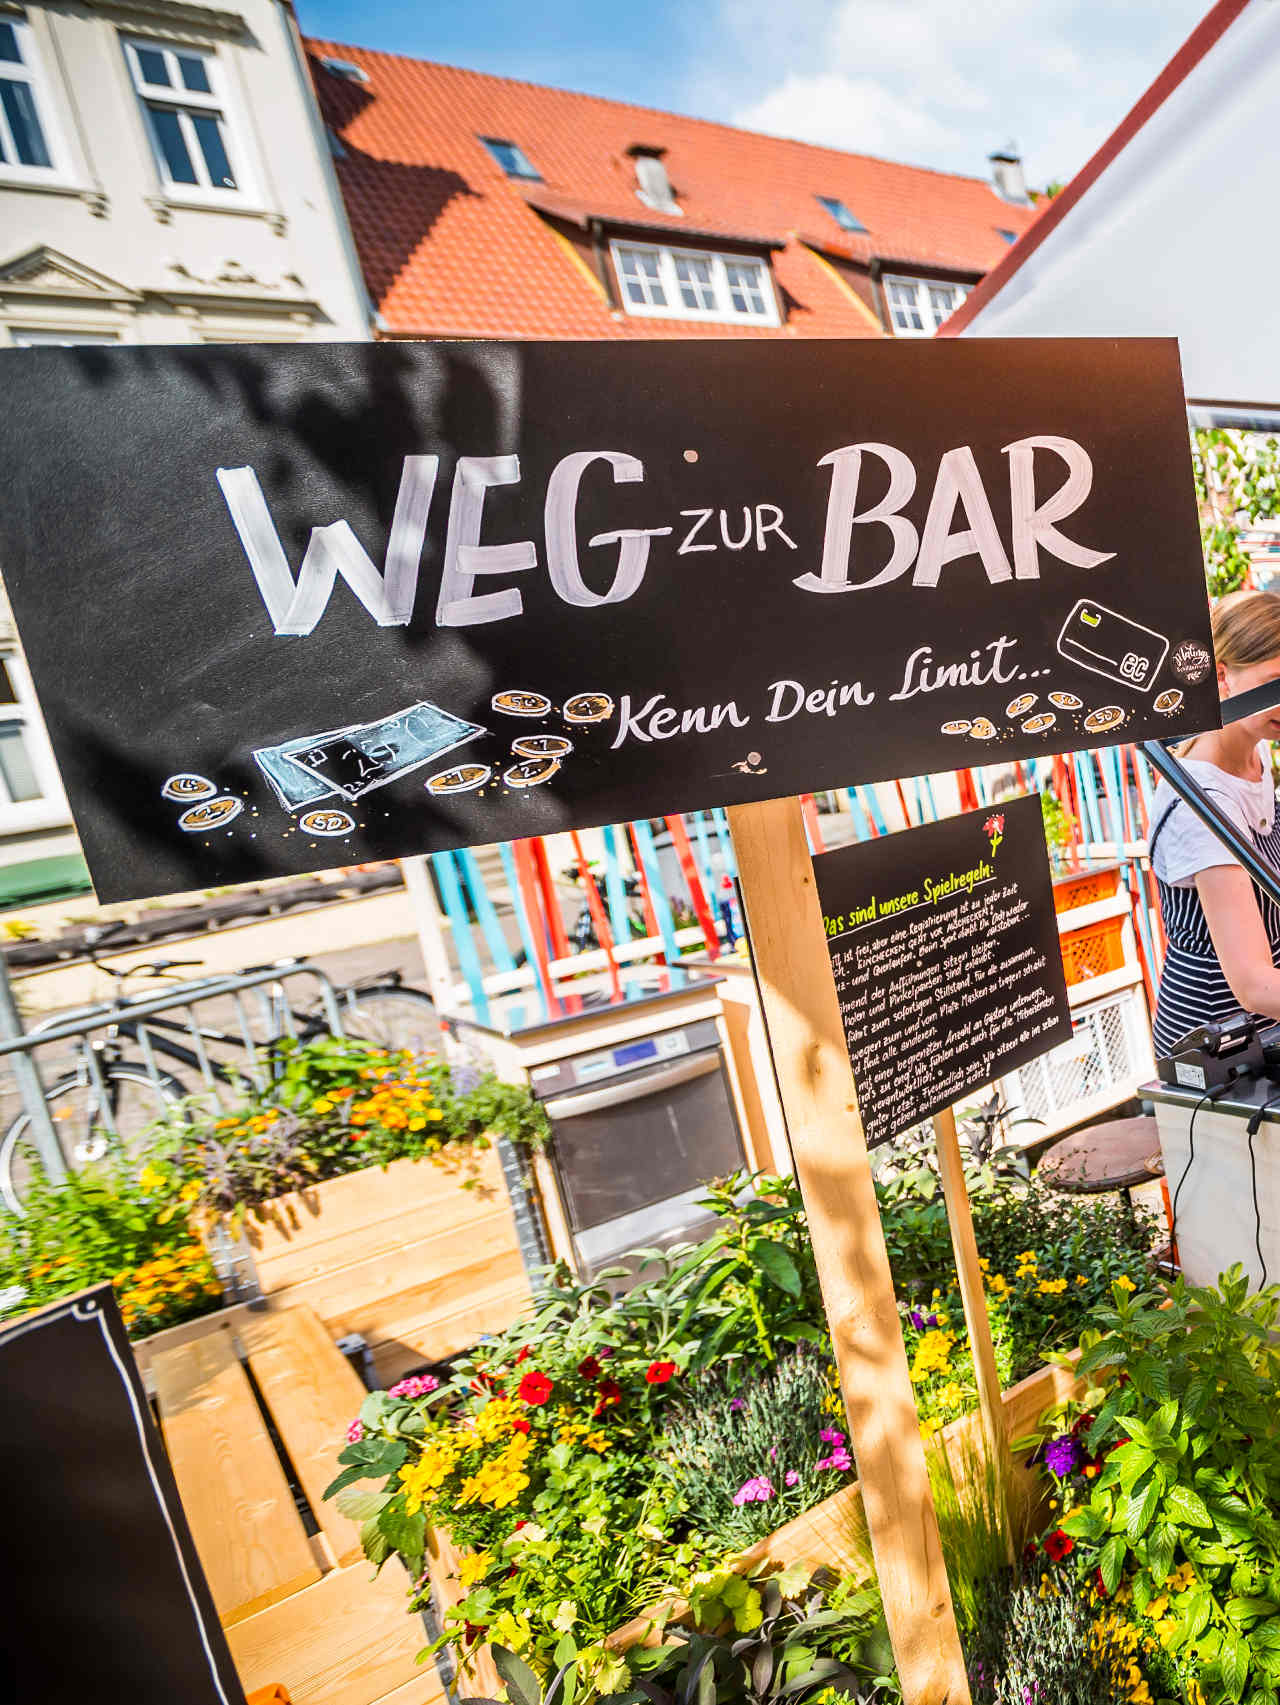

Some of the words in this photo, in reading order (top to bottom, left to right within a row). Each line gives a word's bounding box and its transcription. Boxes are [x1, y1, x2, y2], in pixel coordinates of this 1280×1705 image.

[215, 450, 672, 636] WEG
[678, 503, 798, 554] ZUR
[792, 435, 1118, 594] BAR
[611, 693, 750, 750] Kenn
[765, 679, 875, 723] Dein
[889, 635, 1051, 702] Limit...
[849, 896, 876, 926] sind
[879, 892, 919, 916] unsere
[924, 860, 995, 904] Spielregeln:
[857, 943, 905, 969] EINCHECKEN
[944, 962, 961, 980] sind
